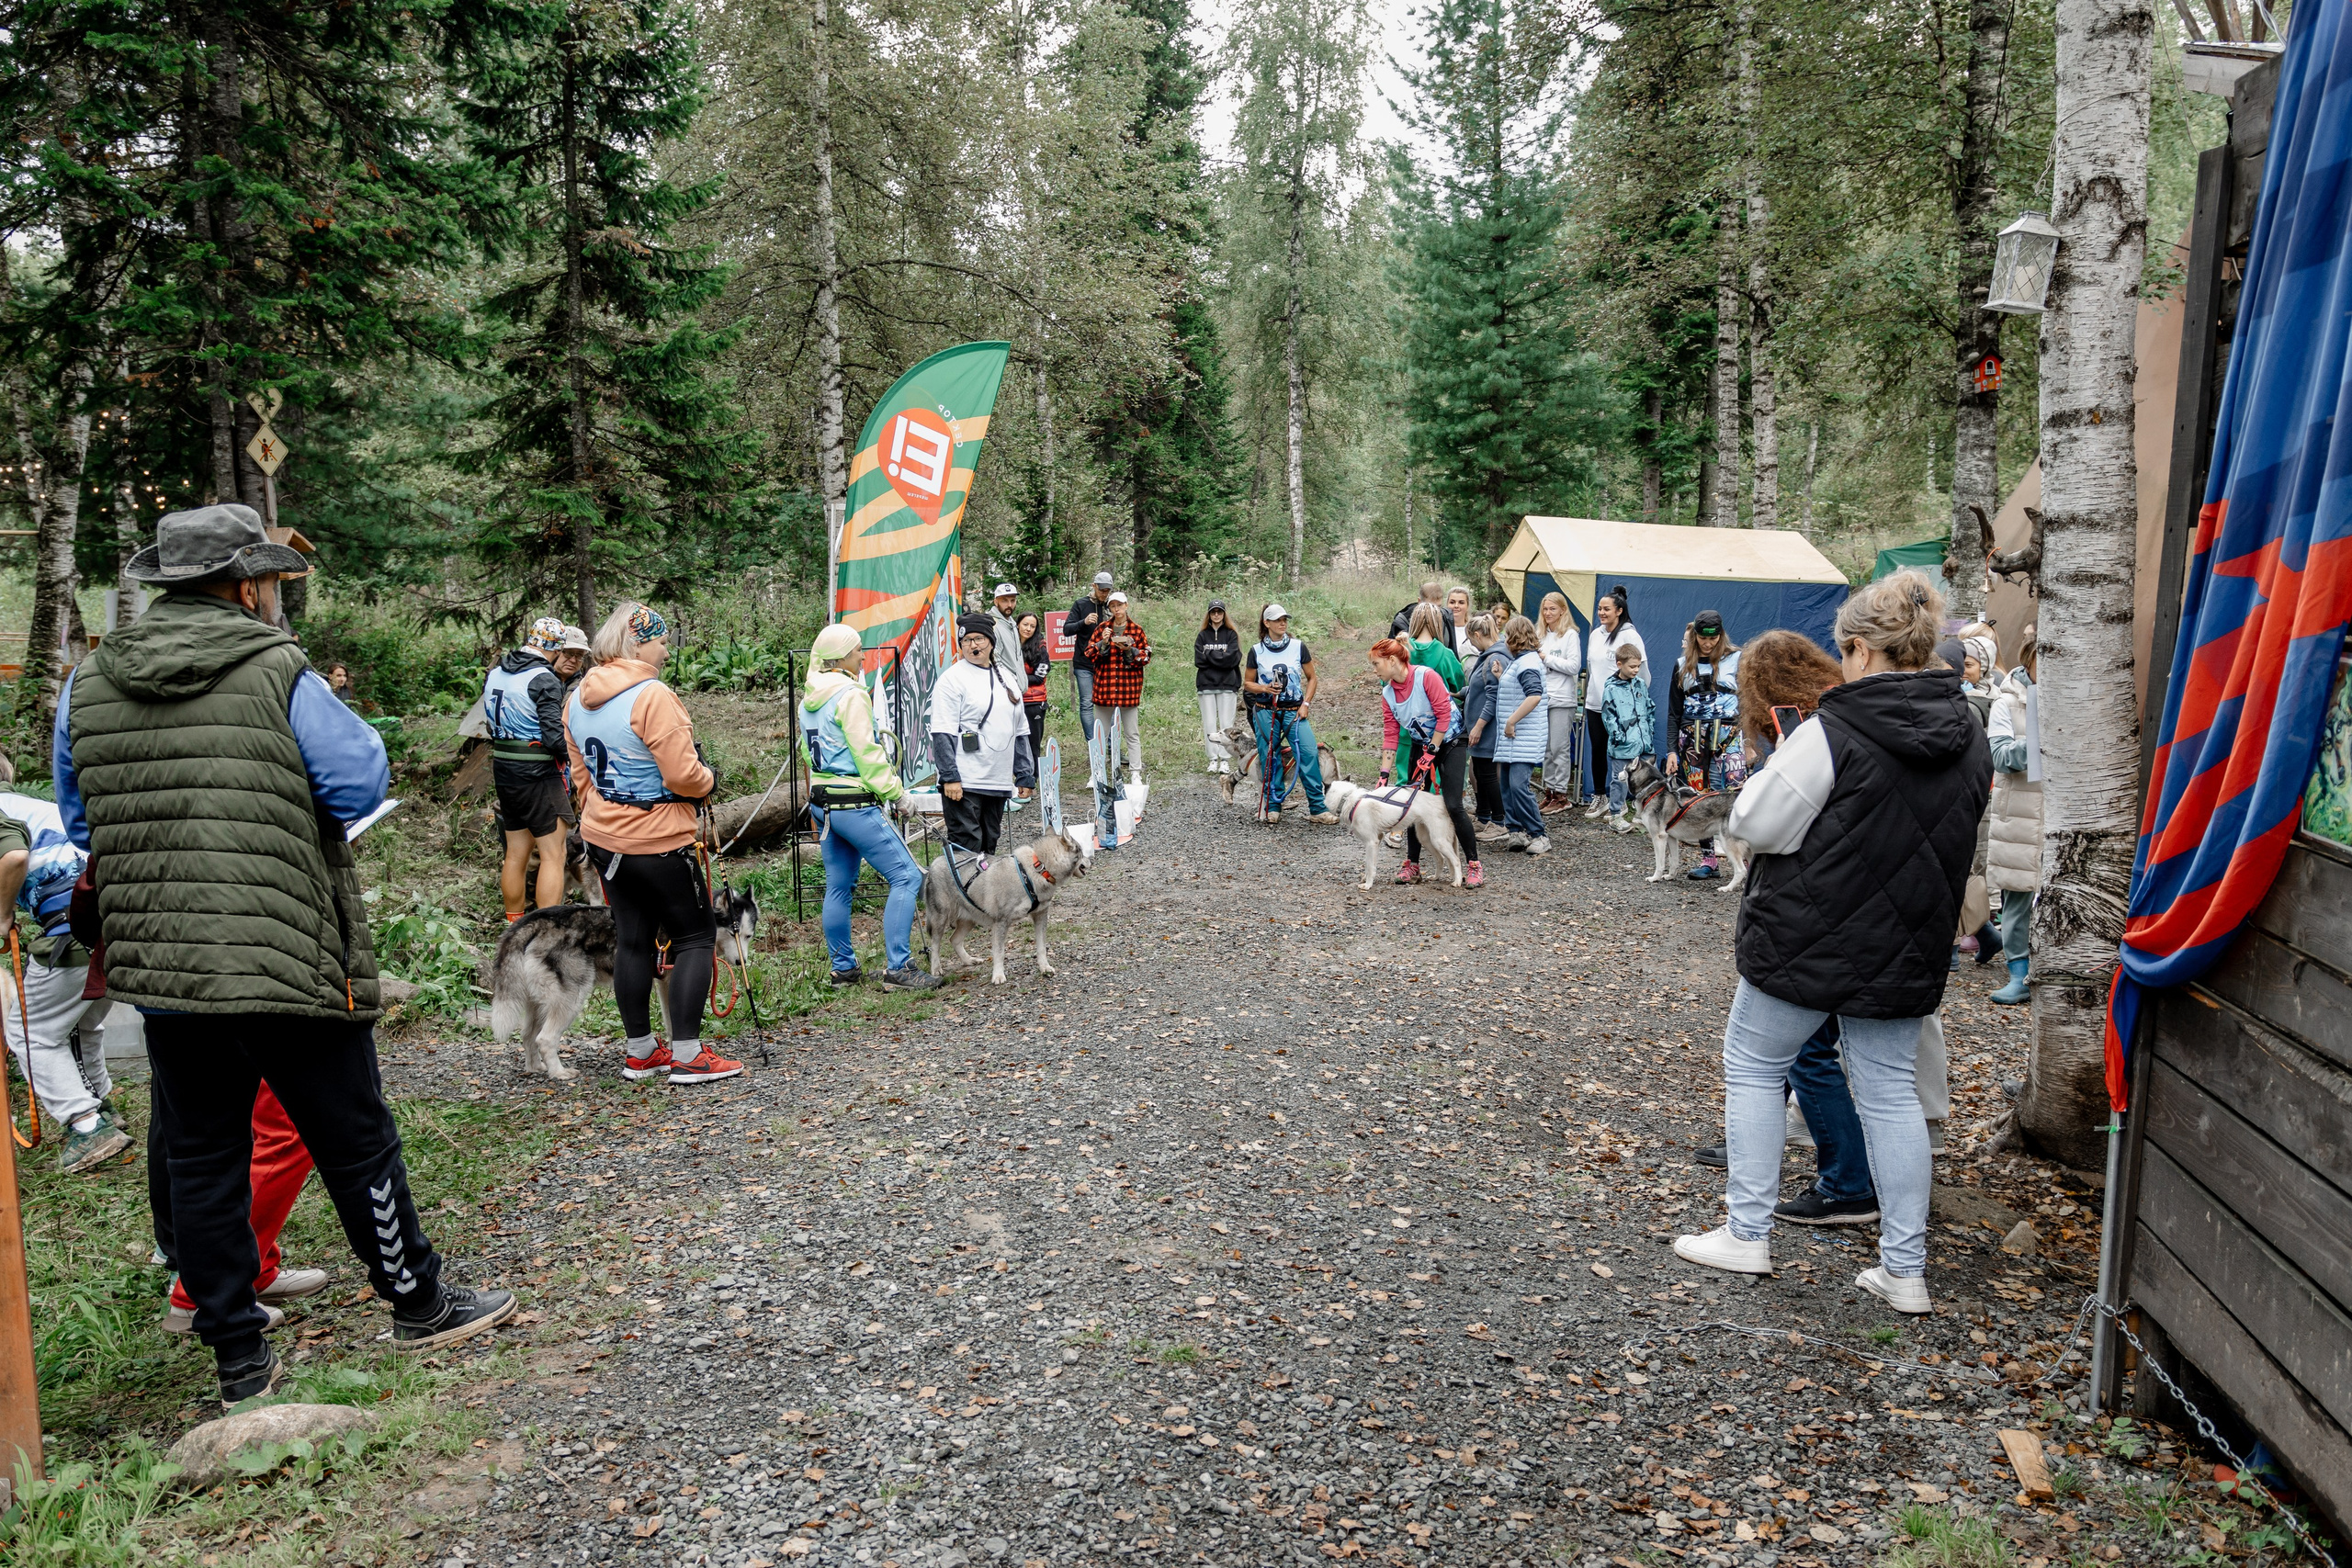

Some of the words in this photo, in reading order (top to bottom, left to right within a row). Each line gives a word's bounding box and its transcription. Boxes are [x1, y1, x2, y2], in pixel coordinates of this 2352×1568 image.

[1056, 618, 1066, 626] Пр
[1058, 634, 1077, 646] СПЕ
[584, 736, 616, 789] 2
[806, 728, 821, 772] 5
[1050, 744, 1058, 775] 2
